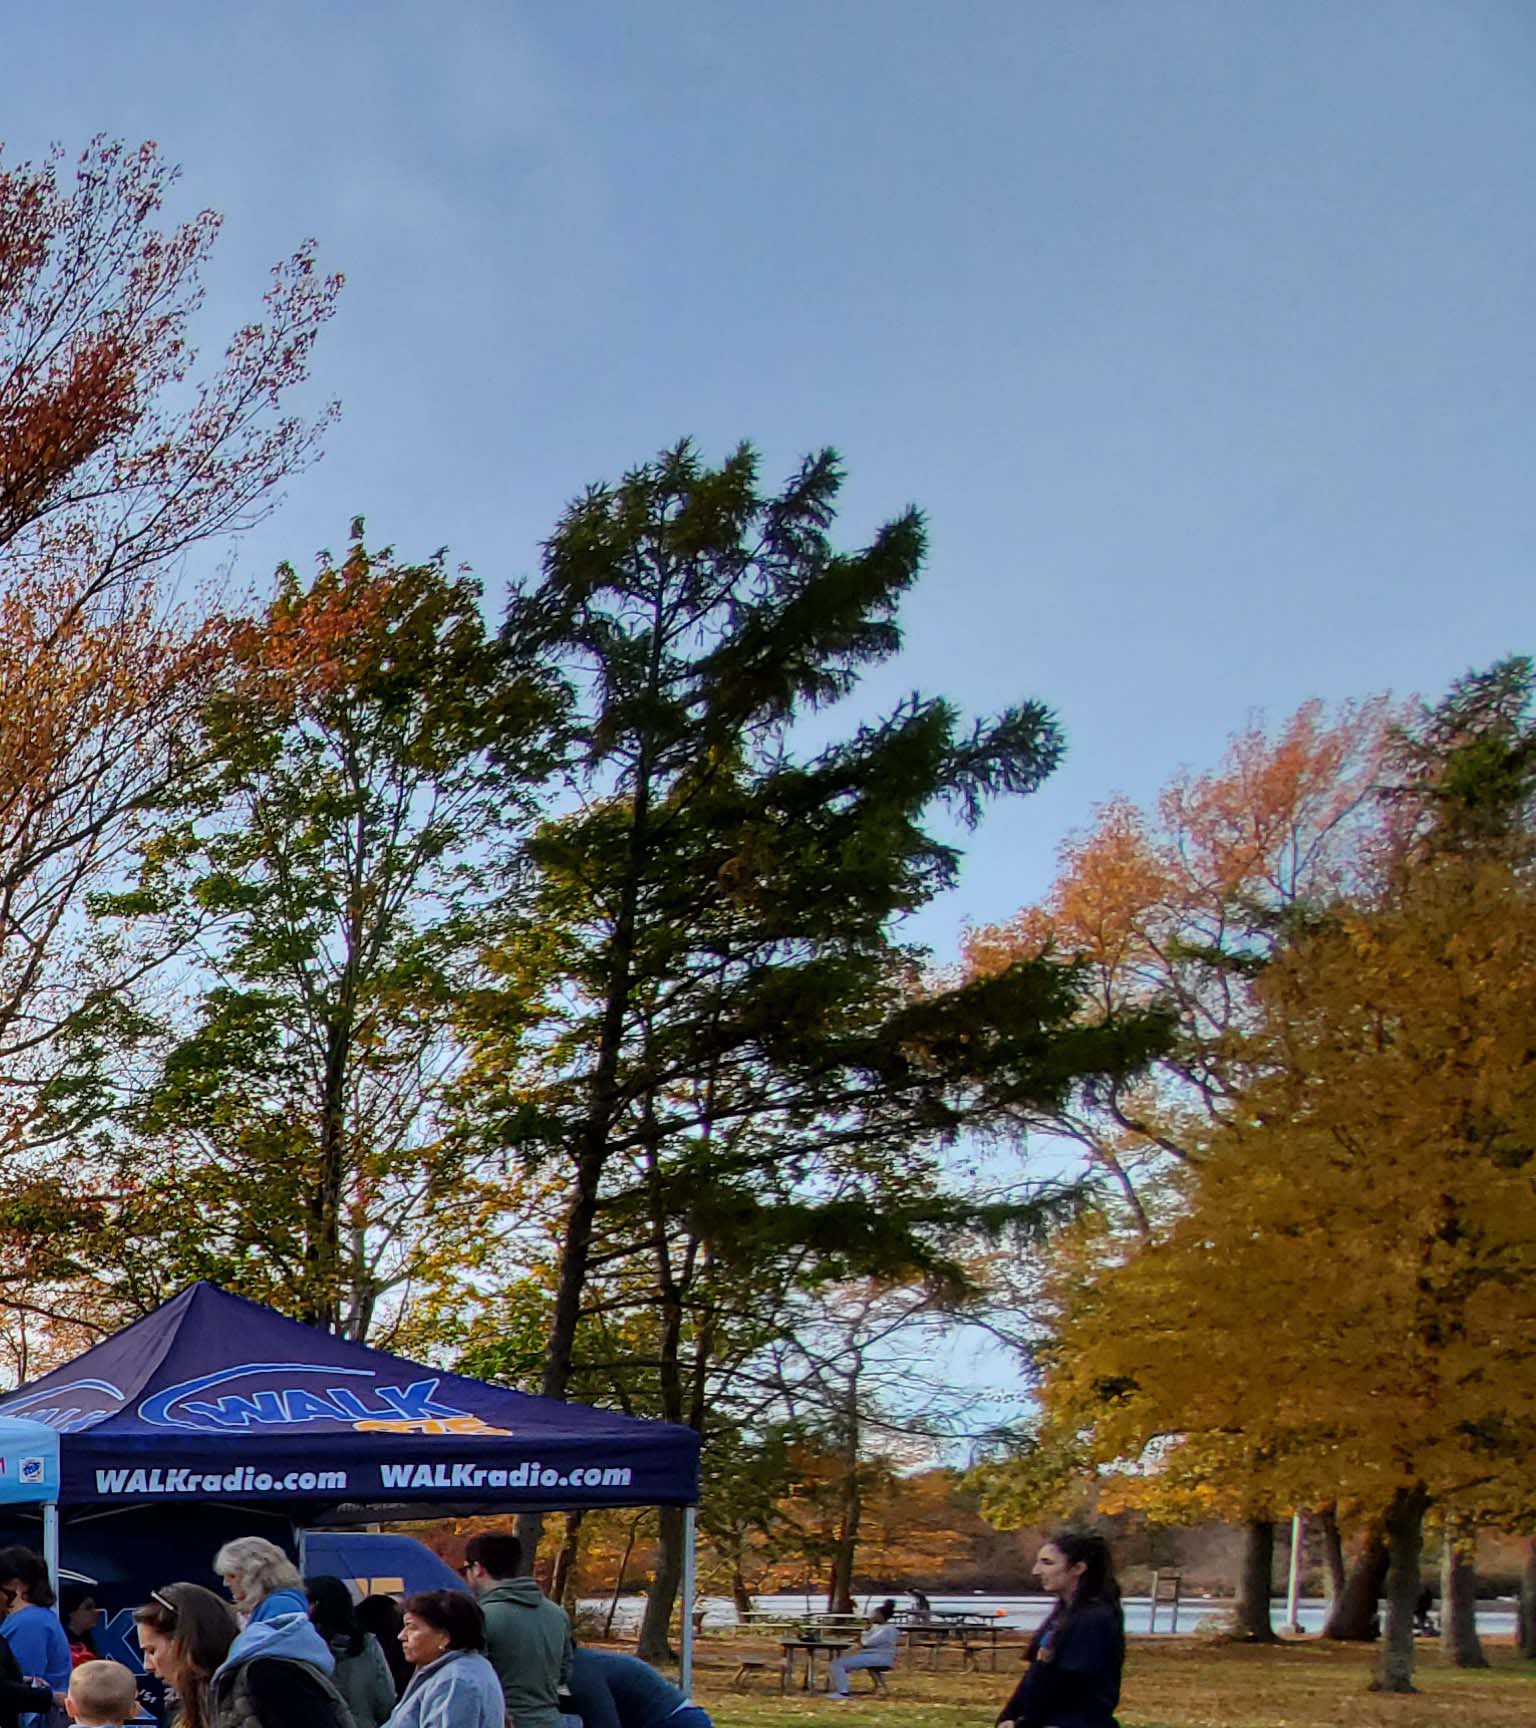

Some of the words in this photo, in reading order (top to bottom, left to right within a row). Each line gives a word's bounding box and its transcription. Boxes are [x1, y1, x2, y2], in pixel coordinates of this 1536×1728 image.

[179, 1378, 474, 1425] WALK
[96, 1466, 347, 1494] WALKradio.com
[380, 1462, 632, 1488] WALKradio.com
